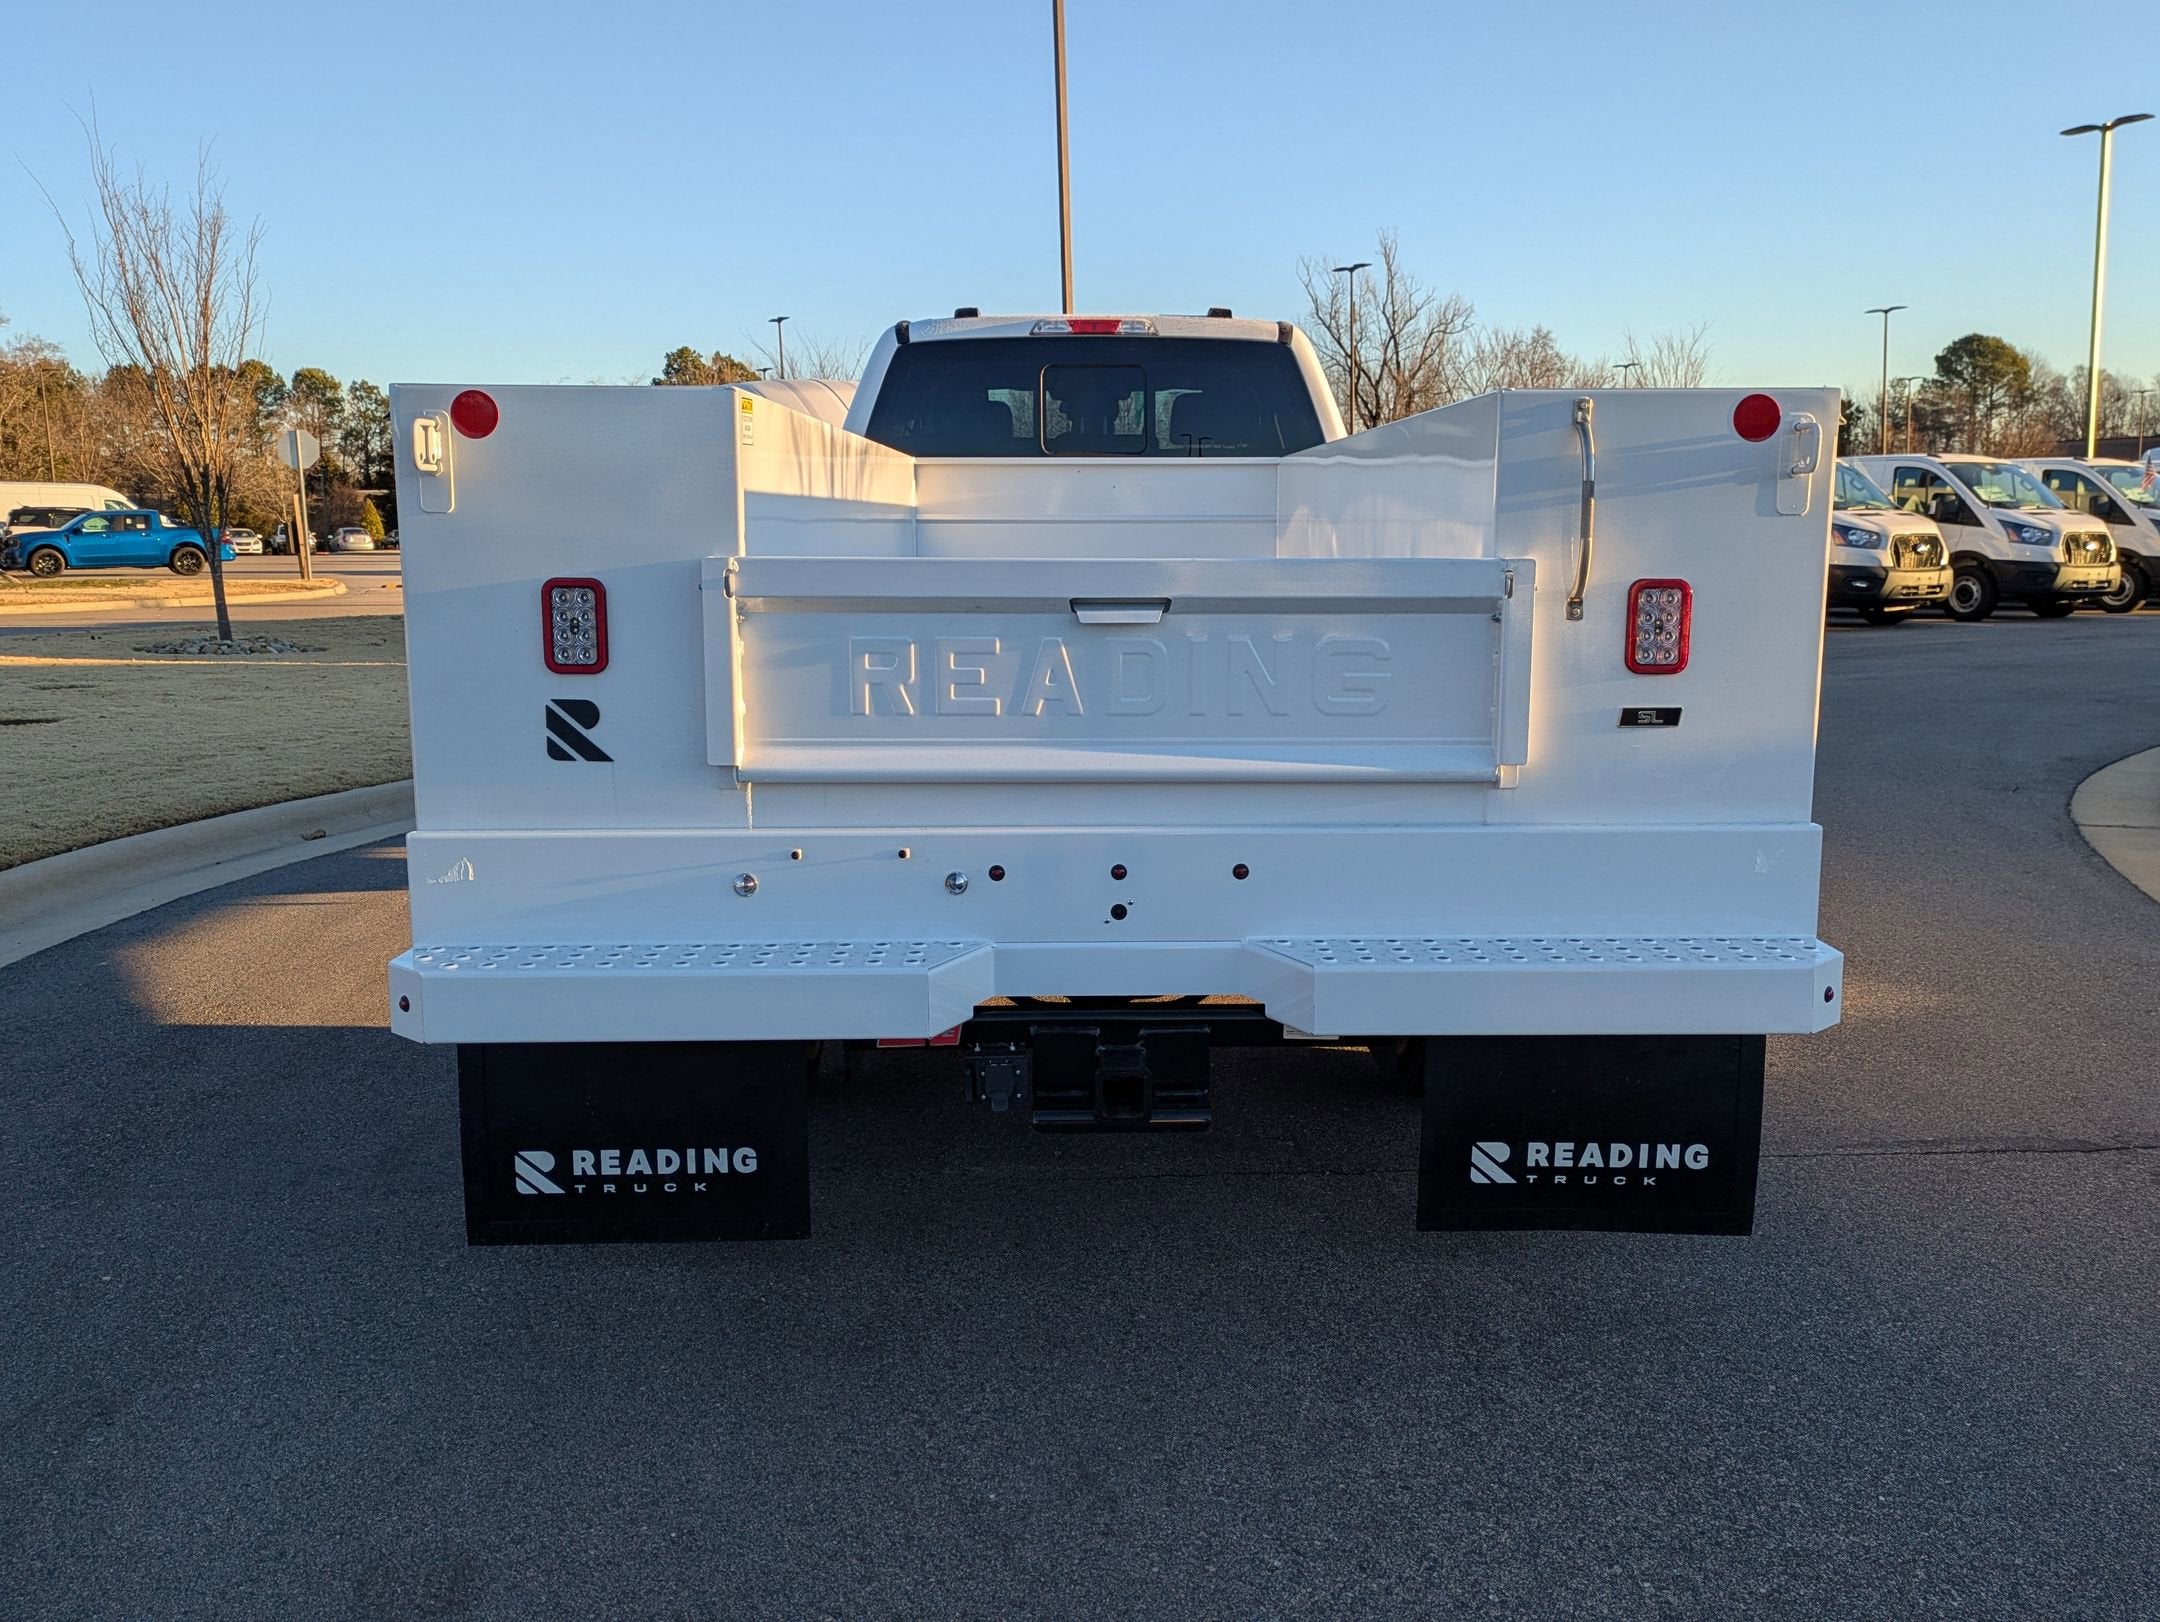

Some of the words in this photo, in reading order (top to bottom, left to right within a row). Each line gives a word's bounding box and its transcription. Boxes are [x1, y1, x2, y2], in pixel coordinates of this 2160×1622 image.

[849, 633, 1392, 717] READING
[1637, 710, 1664, 724] SL
[572, 1146, 758, 1176] READING
[1526, 1141, 1709, 1170] READING
[574, 1182, 707, 1194] TRUCK
[1525, 1174, 1657, 1186] TRUCK
